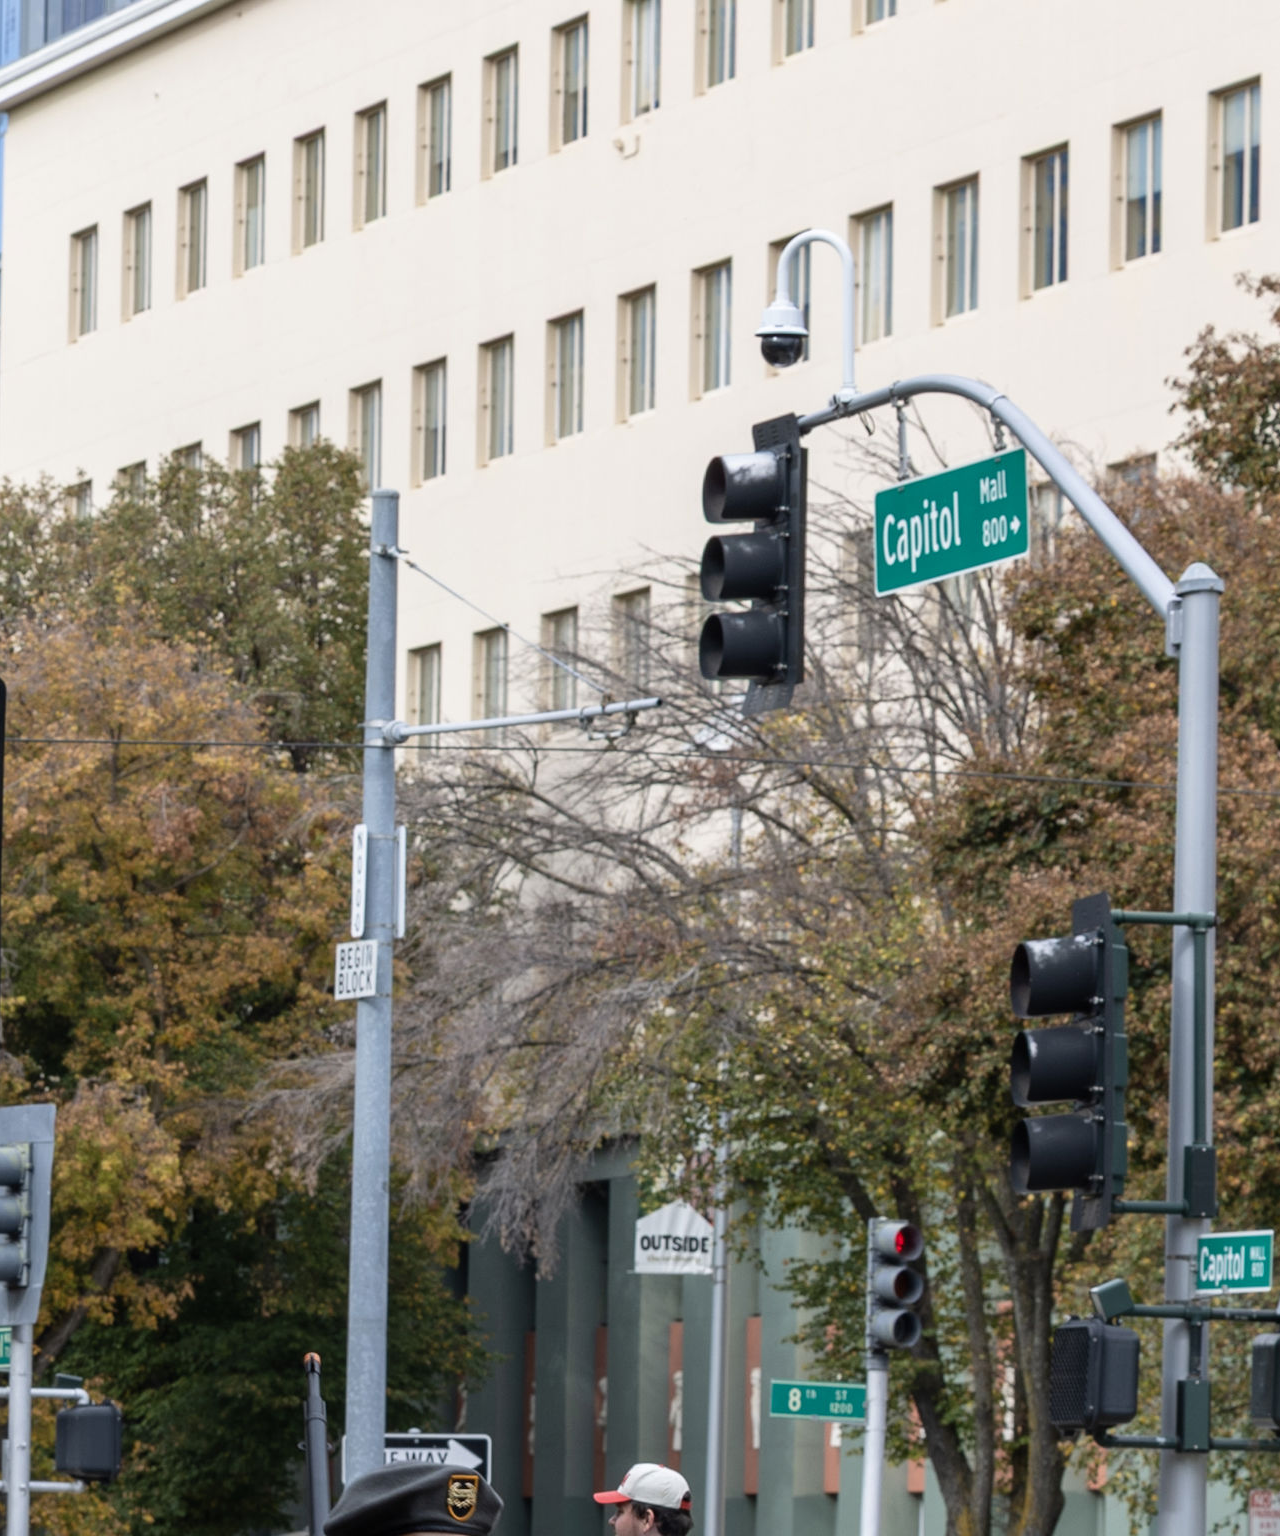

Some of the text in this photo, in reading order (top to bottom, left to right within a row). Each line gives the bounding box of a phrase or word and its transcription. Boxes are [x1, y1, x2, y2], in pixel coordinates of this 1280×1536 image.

[979, 469, 1008, 504] Mall
[883, 491, 962, 574] Capitol
[982, 515, 1008, 547] 800
[339, 943, 374, 970] BEGIN
[338, 969, 373, 995] BLOCK
[640, 1235, 709, 1253] OUTSIDE
[1199, 1245, 1246, 1287] Capitol
